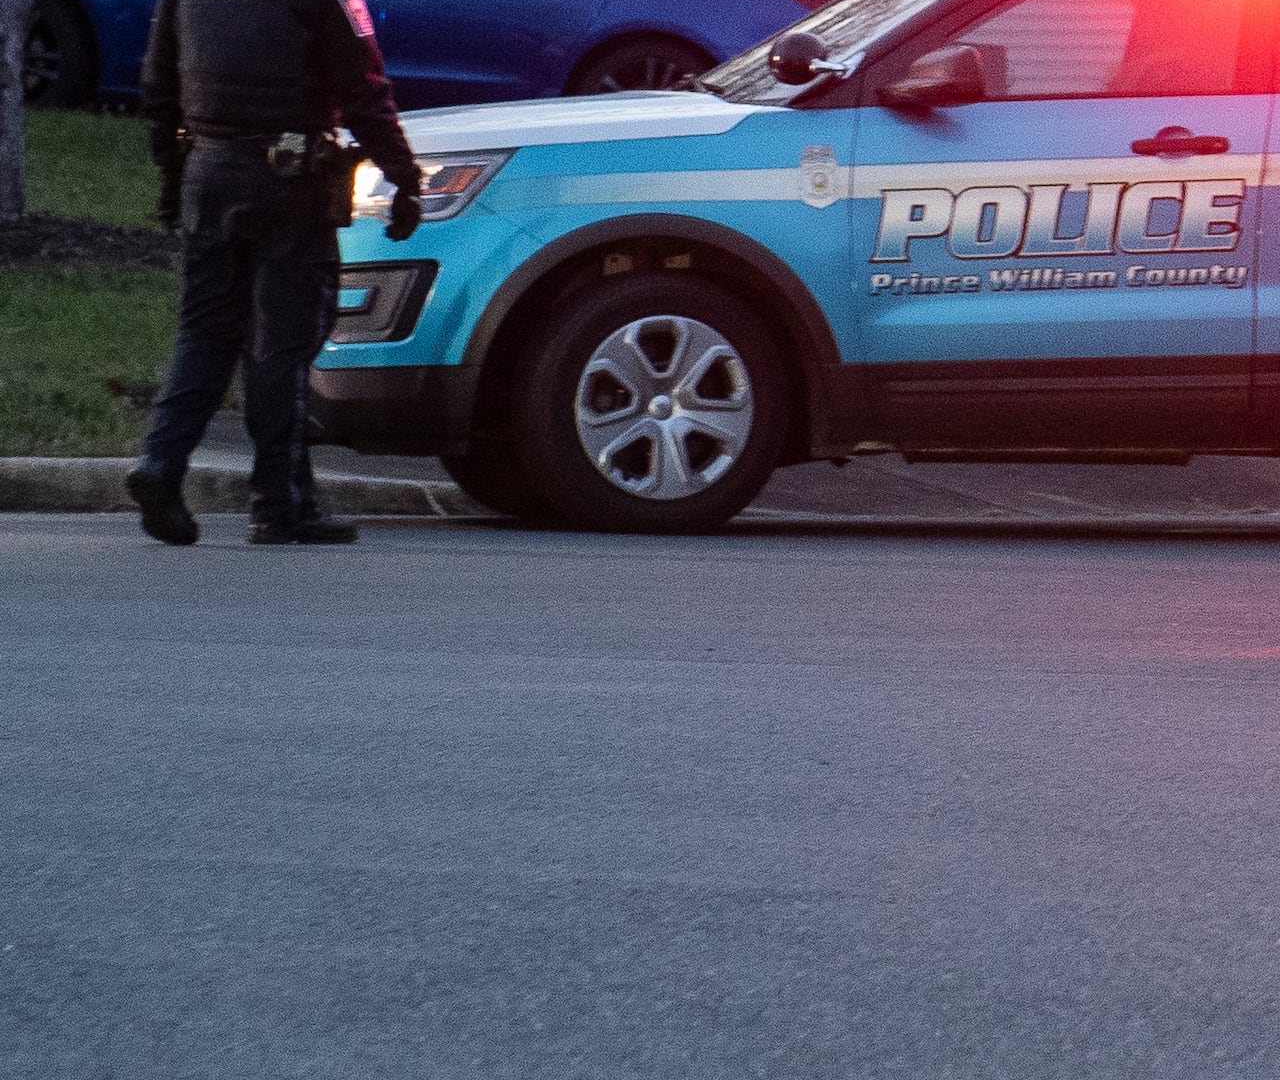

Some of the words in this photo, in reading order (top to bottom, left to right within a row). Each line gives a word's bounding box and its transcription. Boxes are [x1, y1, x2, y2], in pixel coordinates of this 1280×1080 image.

[869, 178, 1245, 263] POLICE
[870, 273, 981, 296] Prince
[989, 268, 1117, 293] William
[1125, 264, 1248, 289] County
